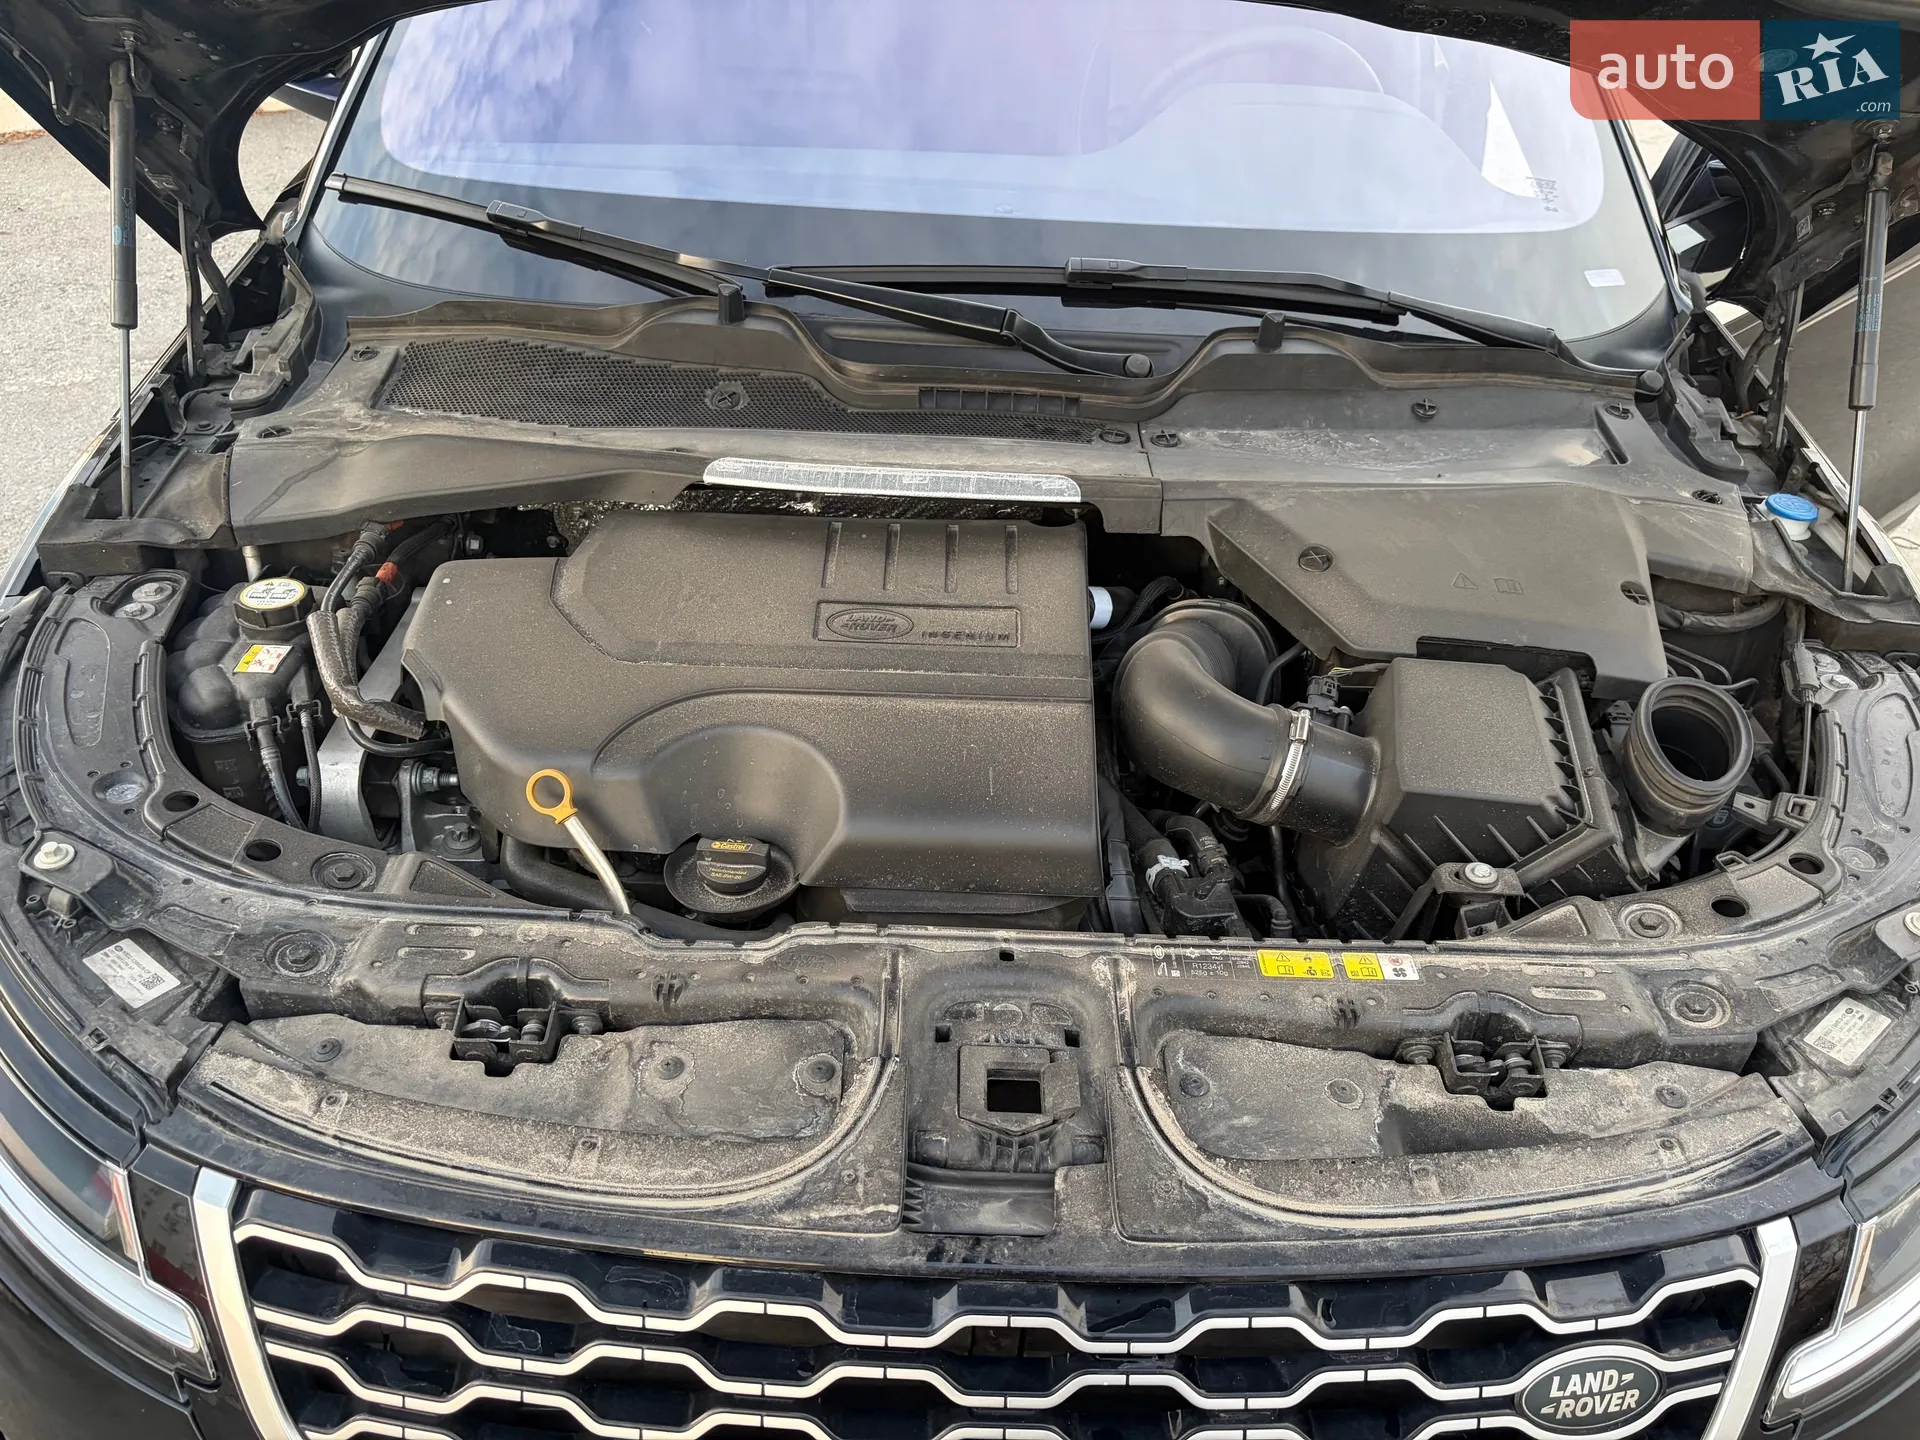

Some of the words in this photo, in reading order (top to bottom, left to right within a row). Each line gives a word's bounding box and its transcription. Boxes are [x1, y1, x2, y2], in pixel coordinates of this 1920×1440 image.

[845, 614, 887, 623] LAND
[848, 622, 899, 632] ROVER
[921, 630, 1010, 642] INGENIUM
[720, 842, 746, 850] Castrol
[1549, 1369, 1619, 1398] LAND
[1555, 1389, 1640, 1420] ROVER
